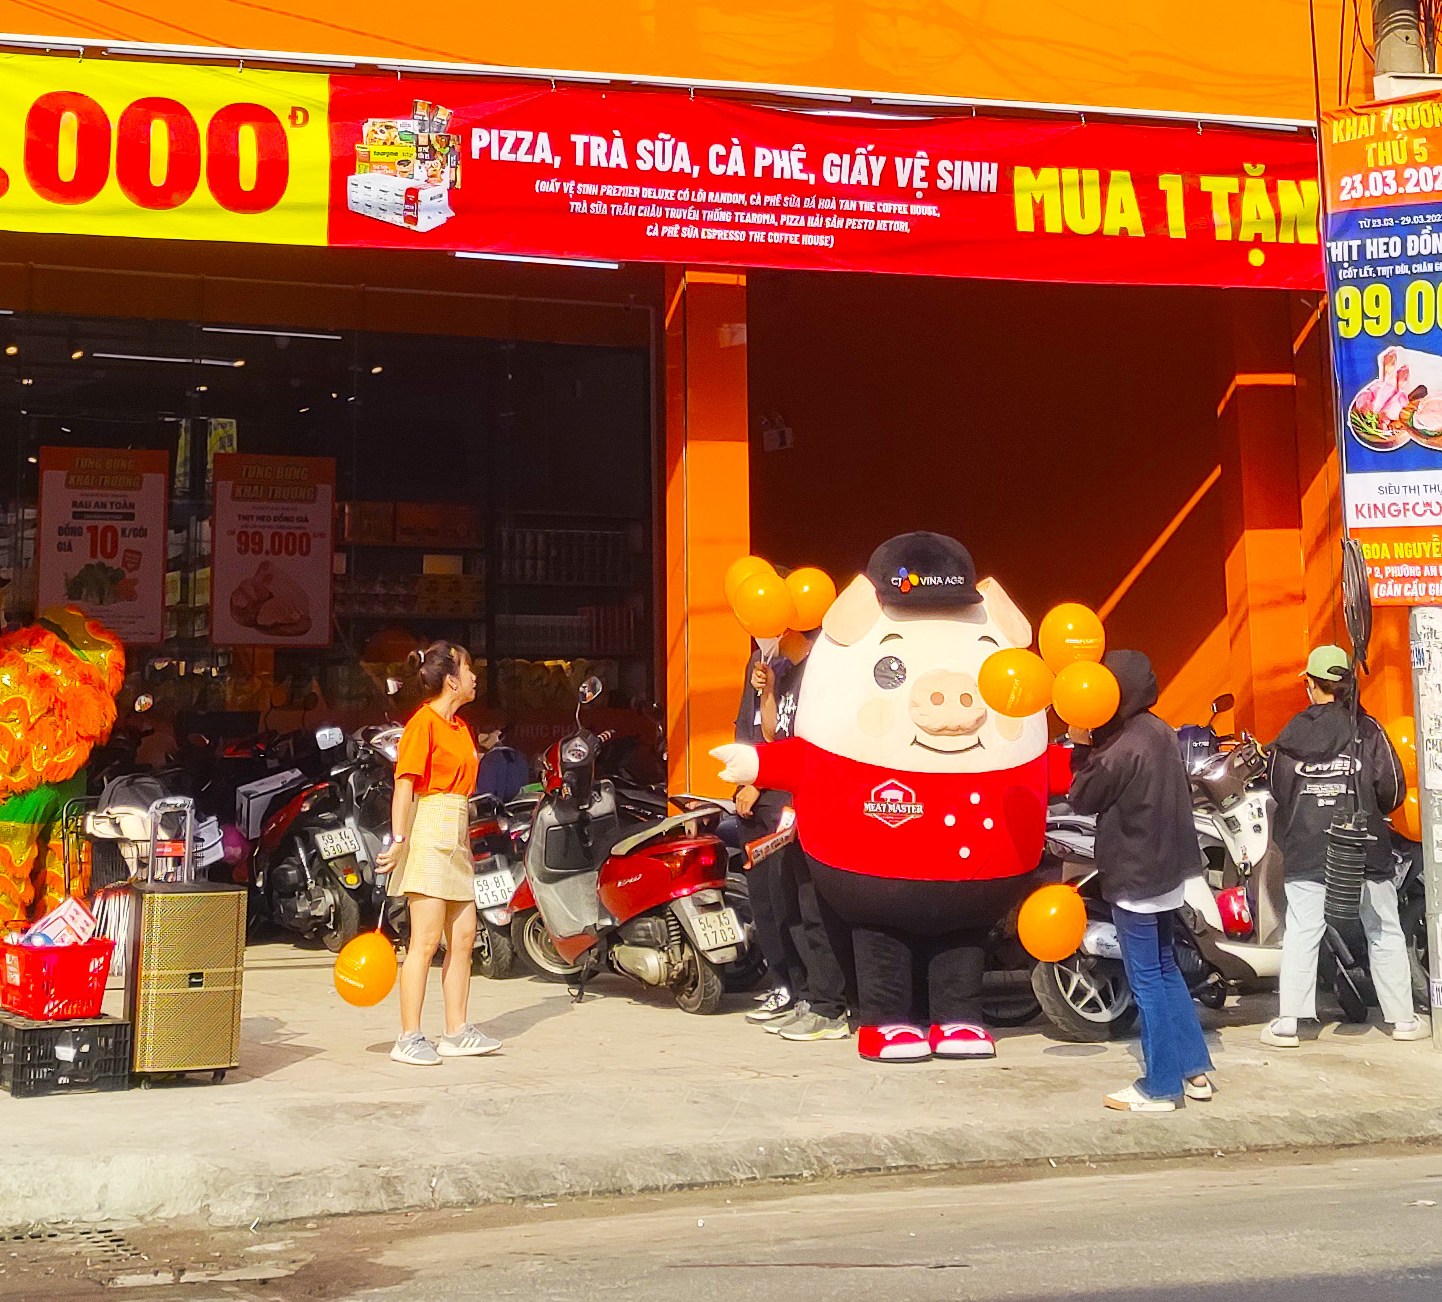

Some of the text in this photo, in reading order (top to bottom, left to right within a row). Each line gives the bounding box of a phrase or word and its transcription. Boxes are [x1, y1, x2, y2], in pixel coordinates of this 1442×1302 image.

[1332, 114, 1377, 144] KHAI
[471, 128, 998, 199] PIZZA, TRÀ SỮA, CÀ PHÊ, GIẤY VỆ SINH
[1365, 135, 1429, 168] THỨ 5
[1013, 162, 1320, 267] MUA 1 TẶN
[1366, 236, 1401, 260] HEO
[1377, 482, 1400, 496] SIÊU
[1403, 484, 1421, 497] THỊ
[86, 525, 119, 560] 10
[237, 530, 312, 557] 99.000
[919, 577, 943, 586] VINA
[864, 802, 923, 815] MEAT MASTER
[703, 927, 736, 947] 1703
